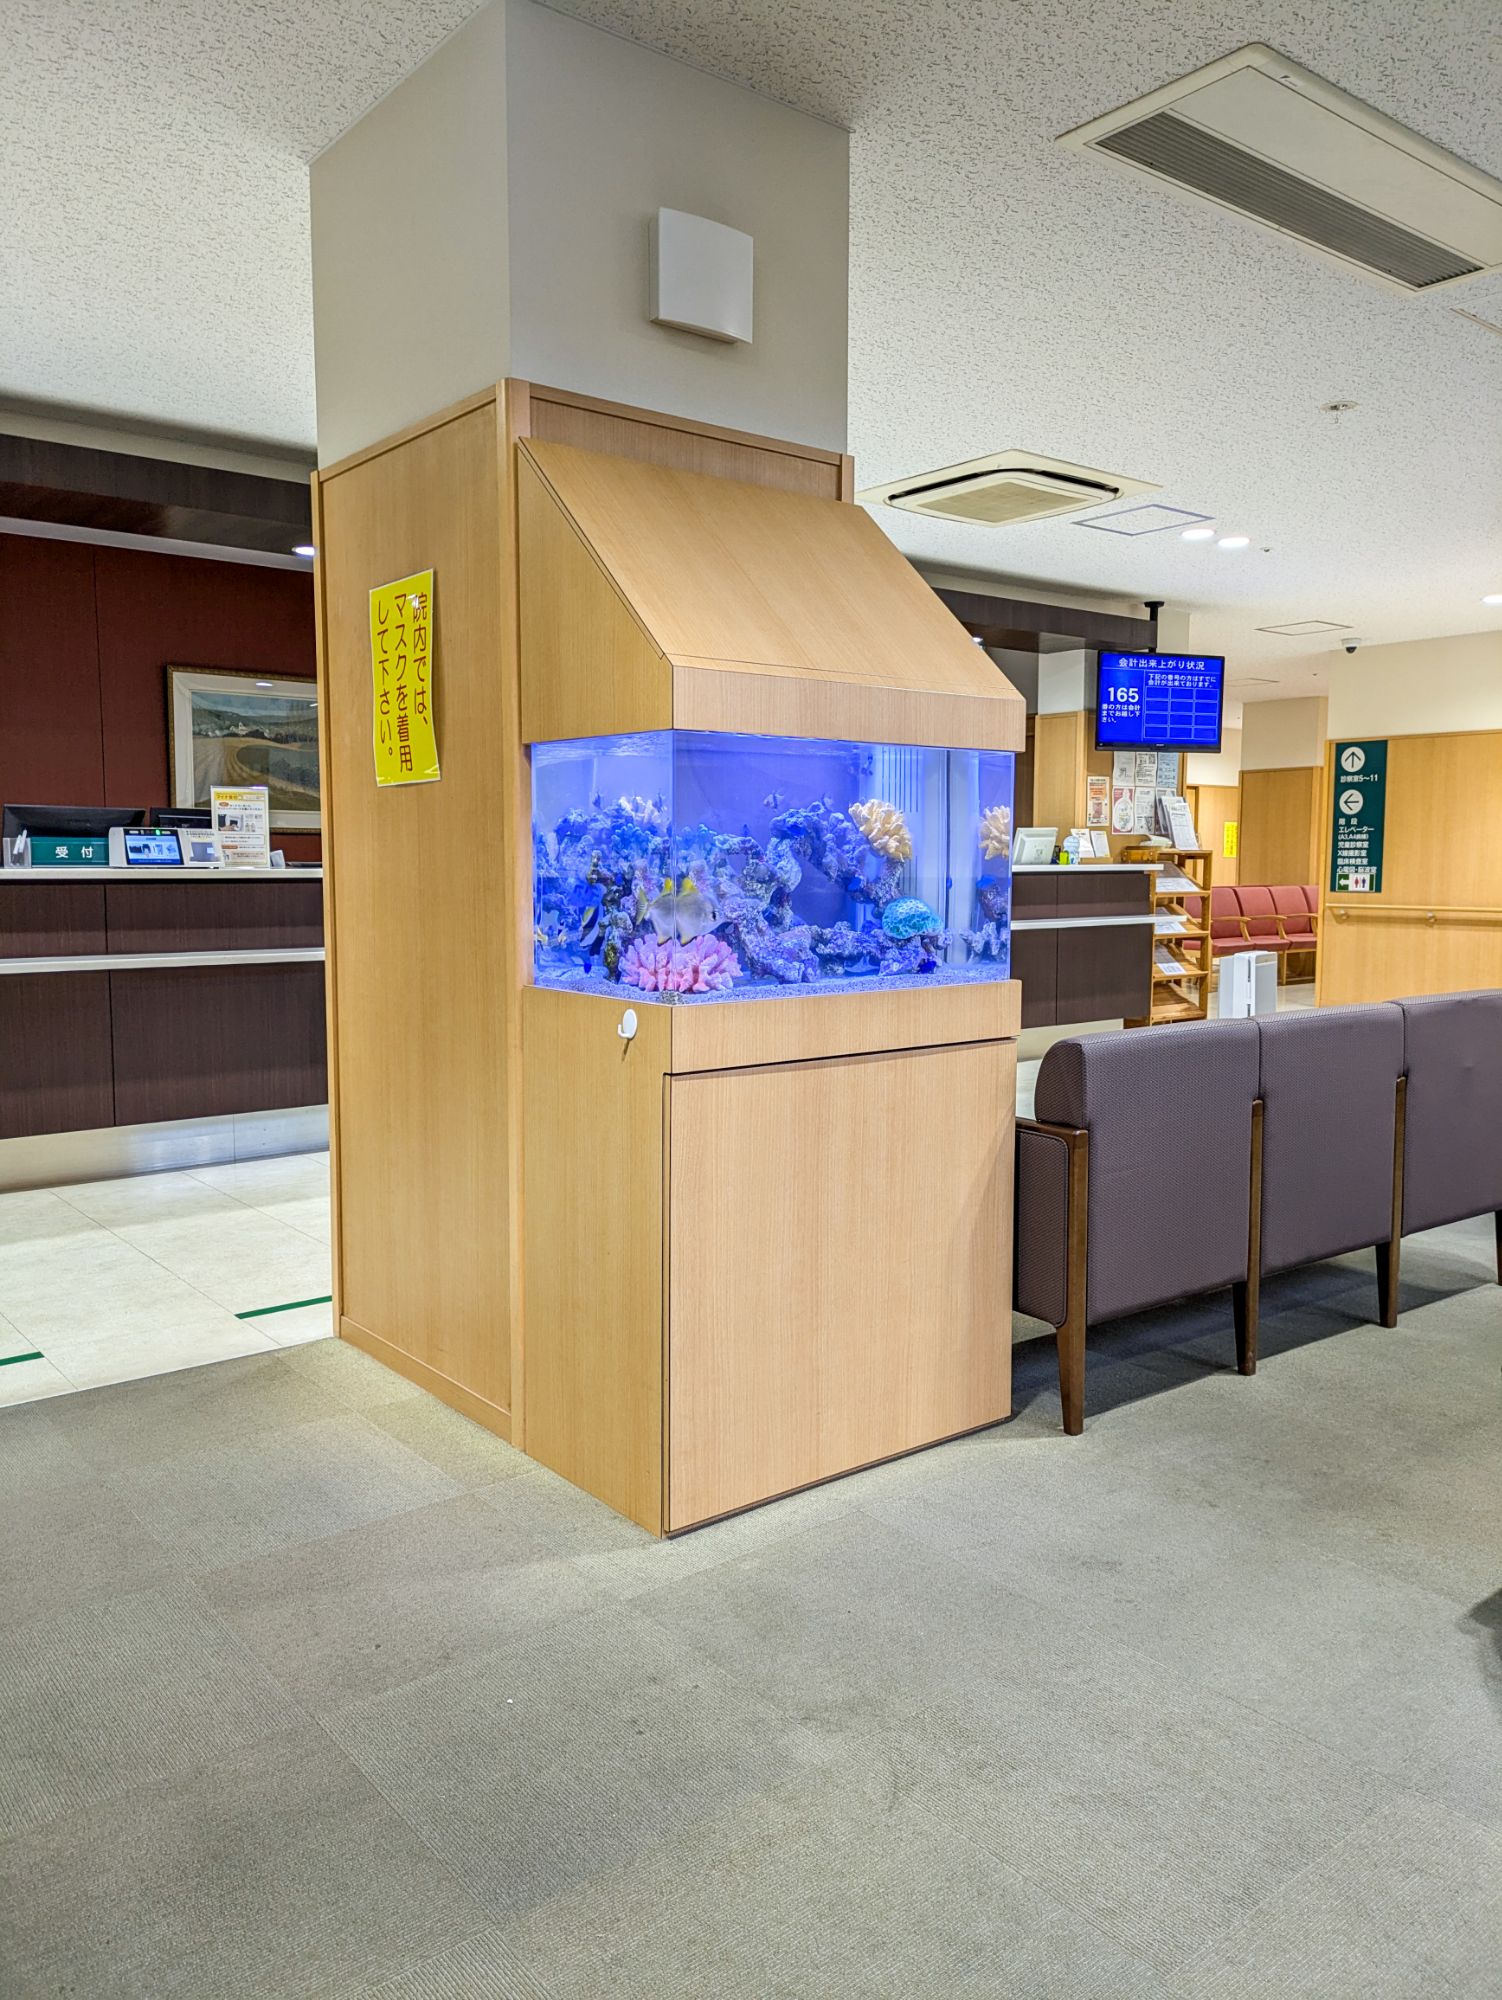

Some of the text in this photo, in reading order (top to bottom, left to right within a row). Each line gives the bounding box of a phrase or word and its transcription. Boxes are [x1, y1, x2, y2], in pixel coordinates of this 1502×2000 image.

[377, 600, 393, 757] して下さい。
[394, 592, 413, 773] マスクを着用
[412, 592, 429, 725] 院内では、
[1107, 687, 1139, 702] 165
[1119, 657, 1205, 670] 会計出来上がり状況
